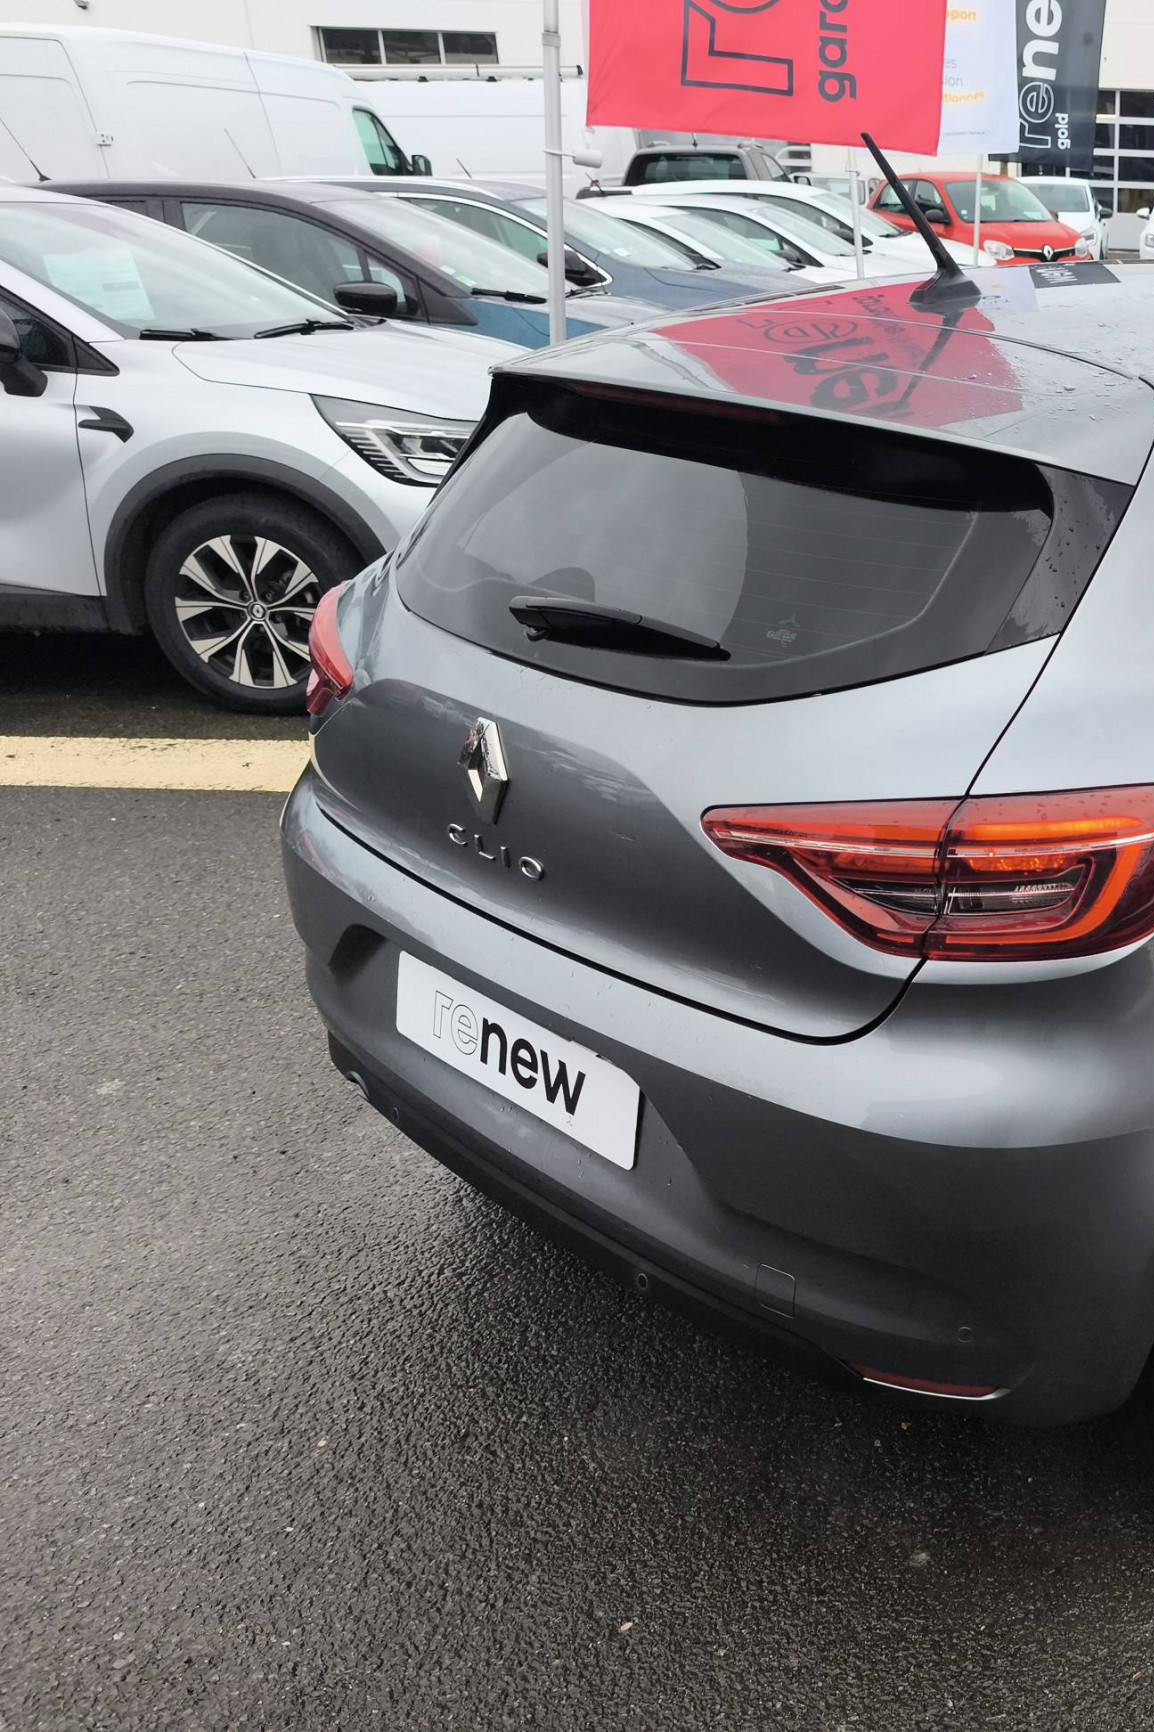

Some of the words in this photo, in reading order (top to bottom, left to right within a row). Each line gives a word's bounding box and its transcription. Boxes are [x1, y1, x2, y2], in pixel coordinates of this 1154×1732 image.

[1055, 113, 1071, 150] gold
[448, 823, 544, 879] CLIO
[433, 990, 586, 1116] renew
